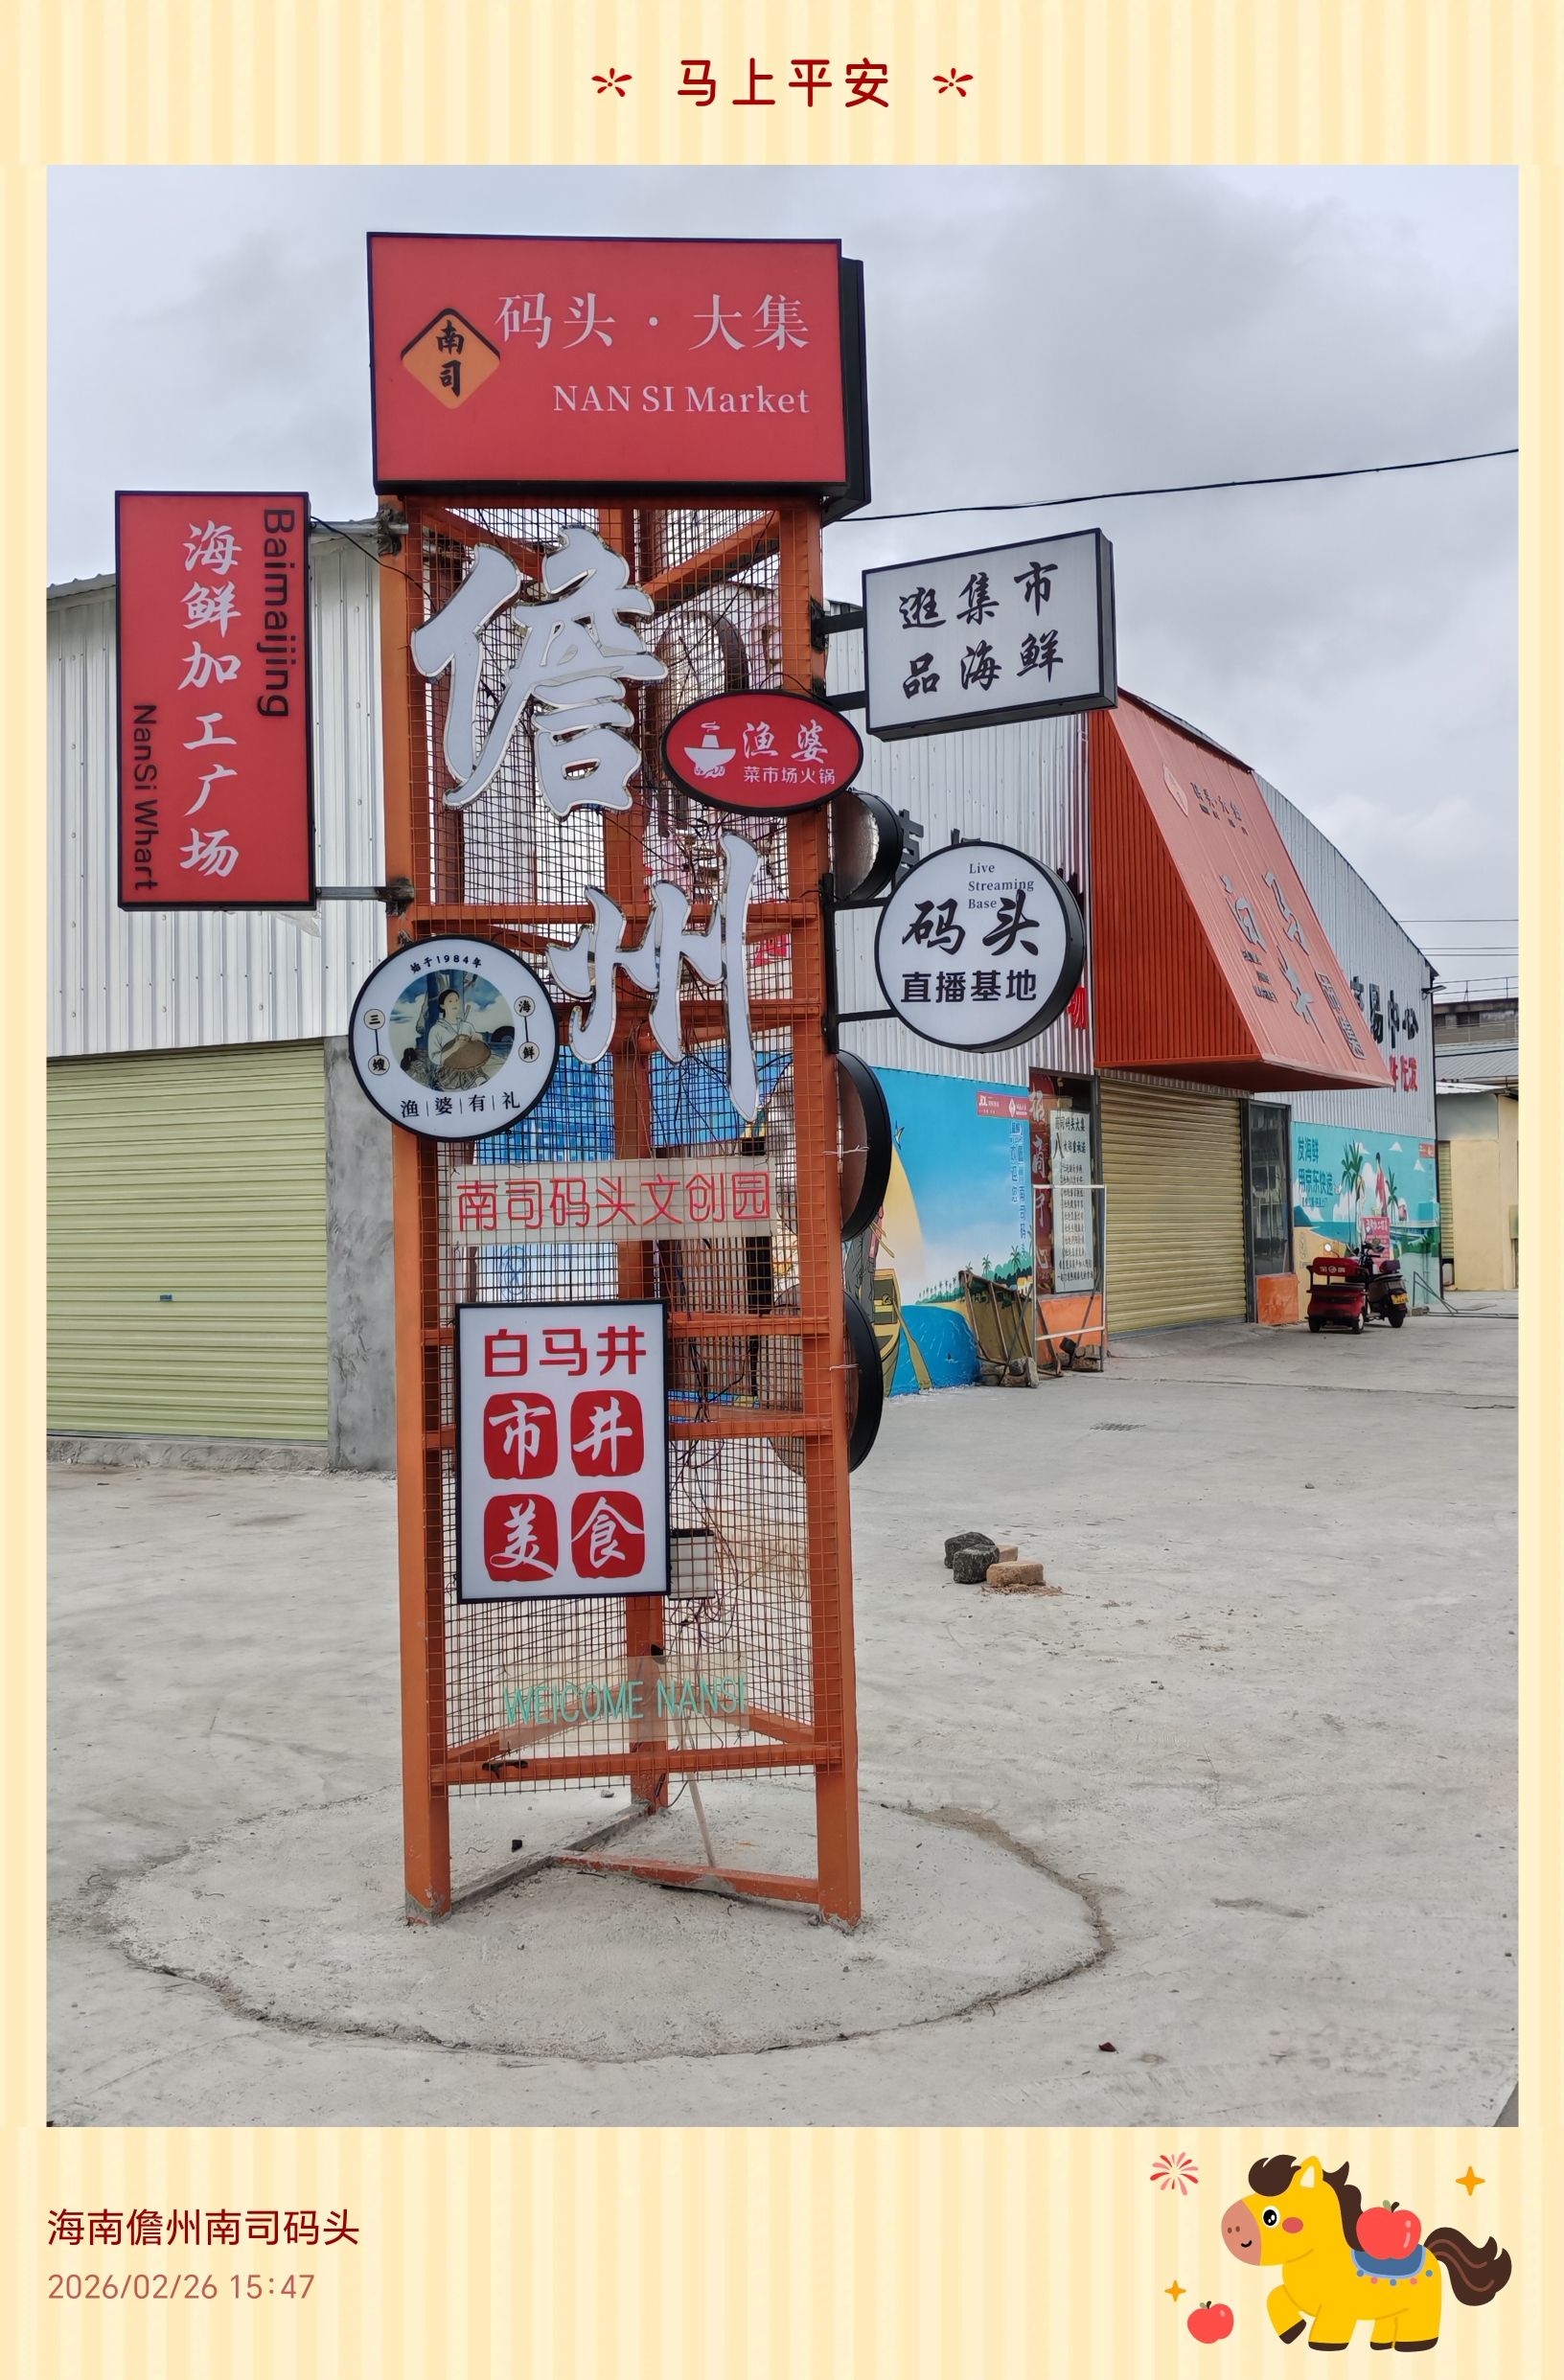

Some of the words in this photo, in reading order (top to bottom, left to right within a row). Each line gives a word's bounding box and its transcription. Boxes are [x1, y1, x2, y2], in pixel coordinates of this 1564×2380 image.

[435, 320, 467, 398] 南司
[553, 385, 631, 412] NAN
[642, 385, 675, 413] SI
[685, 385, 811, 414] Market
[257, 508, 296, 718] Baimaijing
[899, 561, 1058, 630] 逛集市
[903, 629, 1064, 699] 品海鲜
[177, 519, 243, 879] 海鲜加工广场
[133, 704, 158, 790] NanSi
[743, 719, 828, 764] 渔婆
[744, 767, 836, 784] 菜市场火锅
[134, 799, 160, 890] Whart
[411, 525, 763, 1125] 儋州
[968, 878, 1034, 892] Streaming
[969, 862, 996, 874] Live
[901, 889, 1041, 956] 码头
[968, 899, 998, 909] Base
[410, 953, 482, 973] 始于1984年
[901, 970, 1038, 1003] 直播基地
[457, 1171, 770, 1232] 南司码头文创园
[484, 1326, 647, 1378] 白马井
[489, 1396, 633, 1476] 市井
[490, 1497, 645, 1576] 美食
[656, 1671, 747, 1718] NANSI
